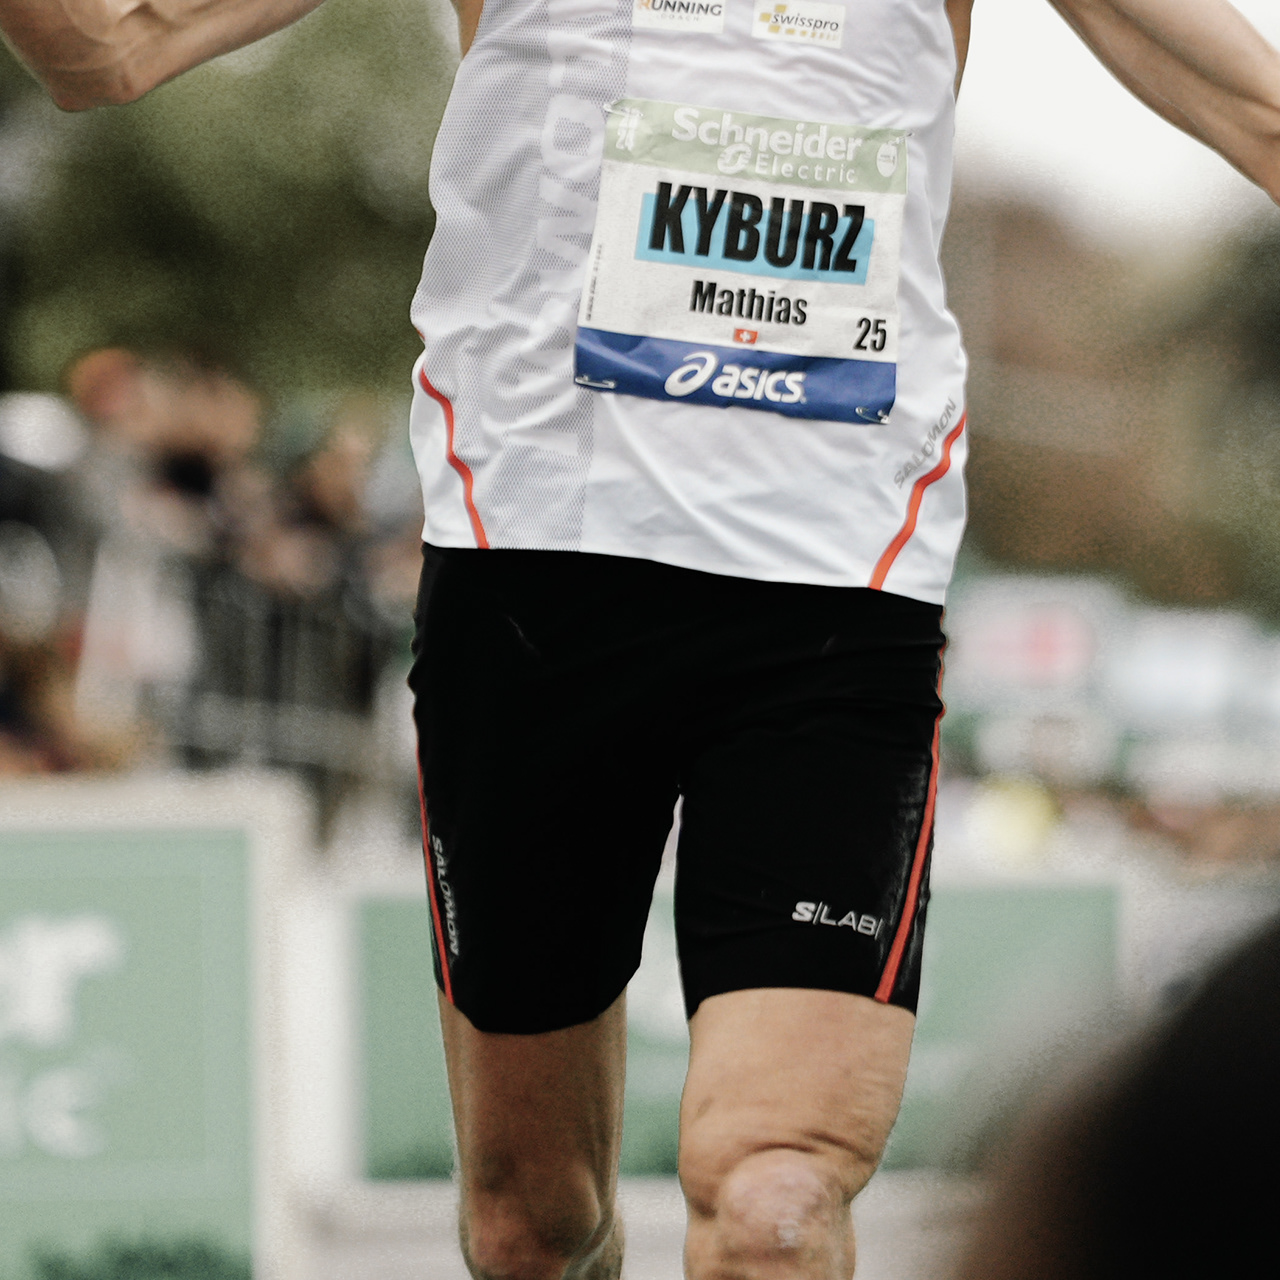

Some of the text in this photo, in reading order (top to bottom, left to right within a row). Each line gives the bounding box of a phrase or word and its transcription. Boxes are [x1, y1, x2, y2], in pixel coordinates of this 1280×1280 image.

[660, 13, 700, 22] COACH
[771, 12, 839, 32] swisspro
[671, 106, 863, 162] Schneider
[754, 152, 857, 185] Electric
[648, 180, 866, 273] KYBURZ
[689, 280, 808, 326] Mathias
[853, 317, 888, 353] 25
[894, 397, 957, 490] SALOMON
[432, 834, 460, 957] SALOMON
